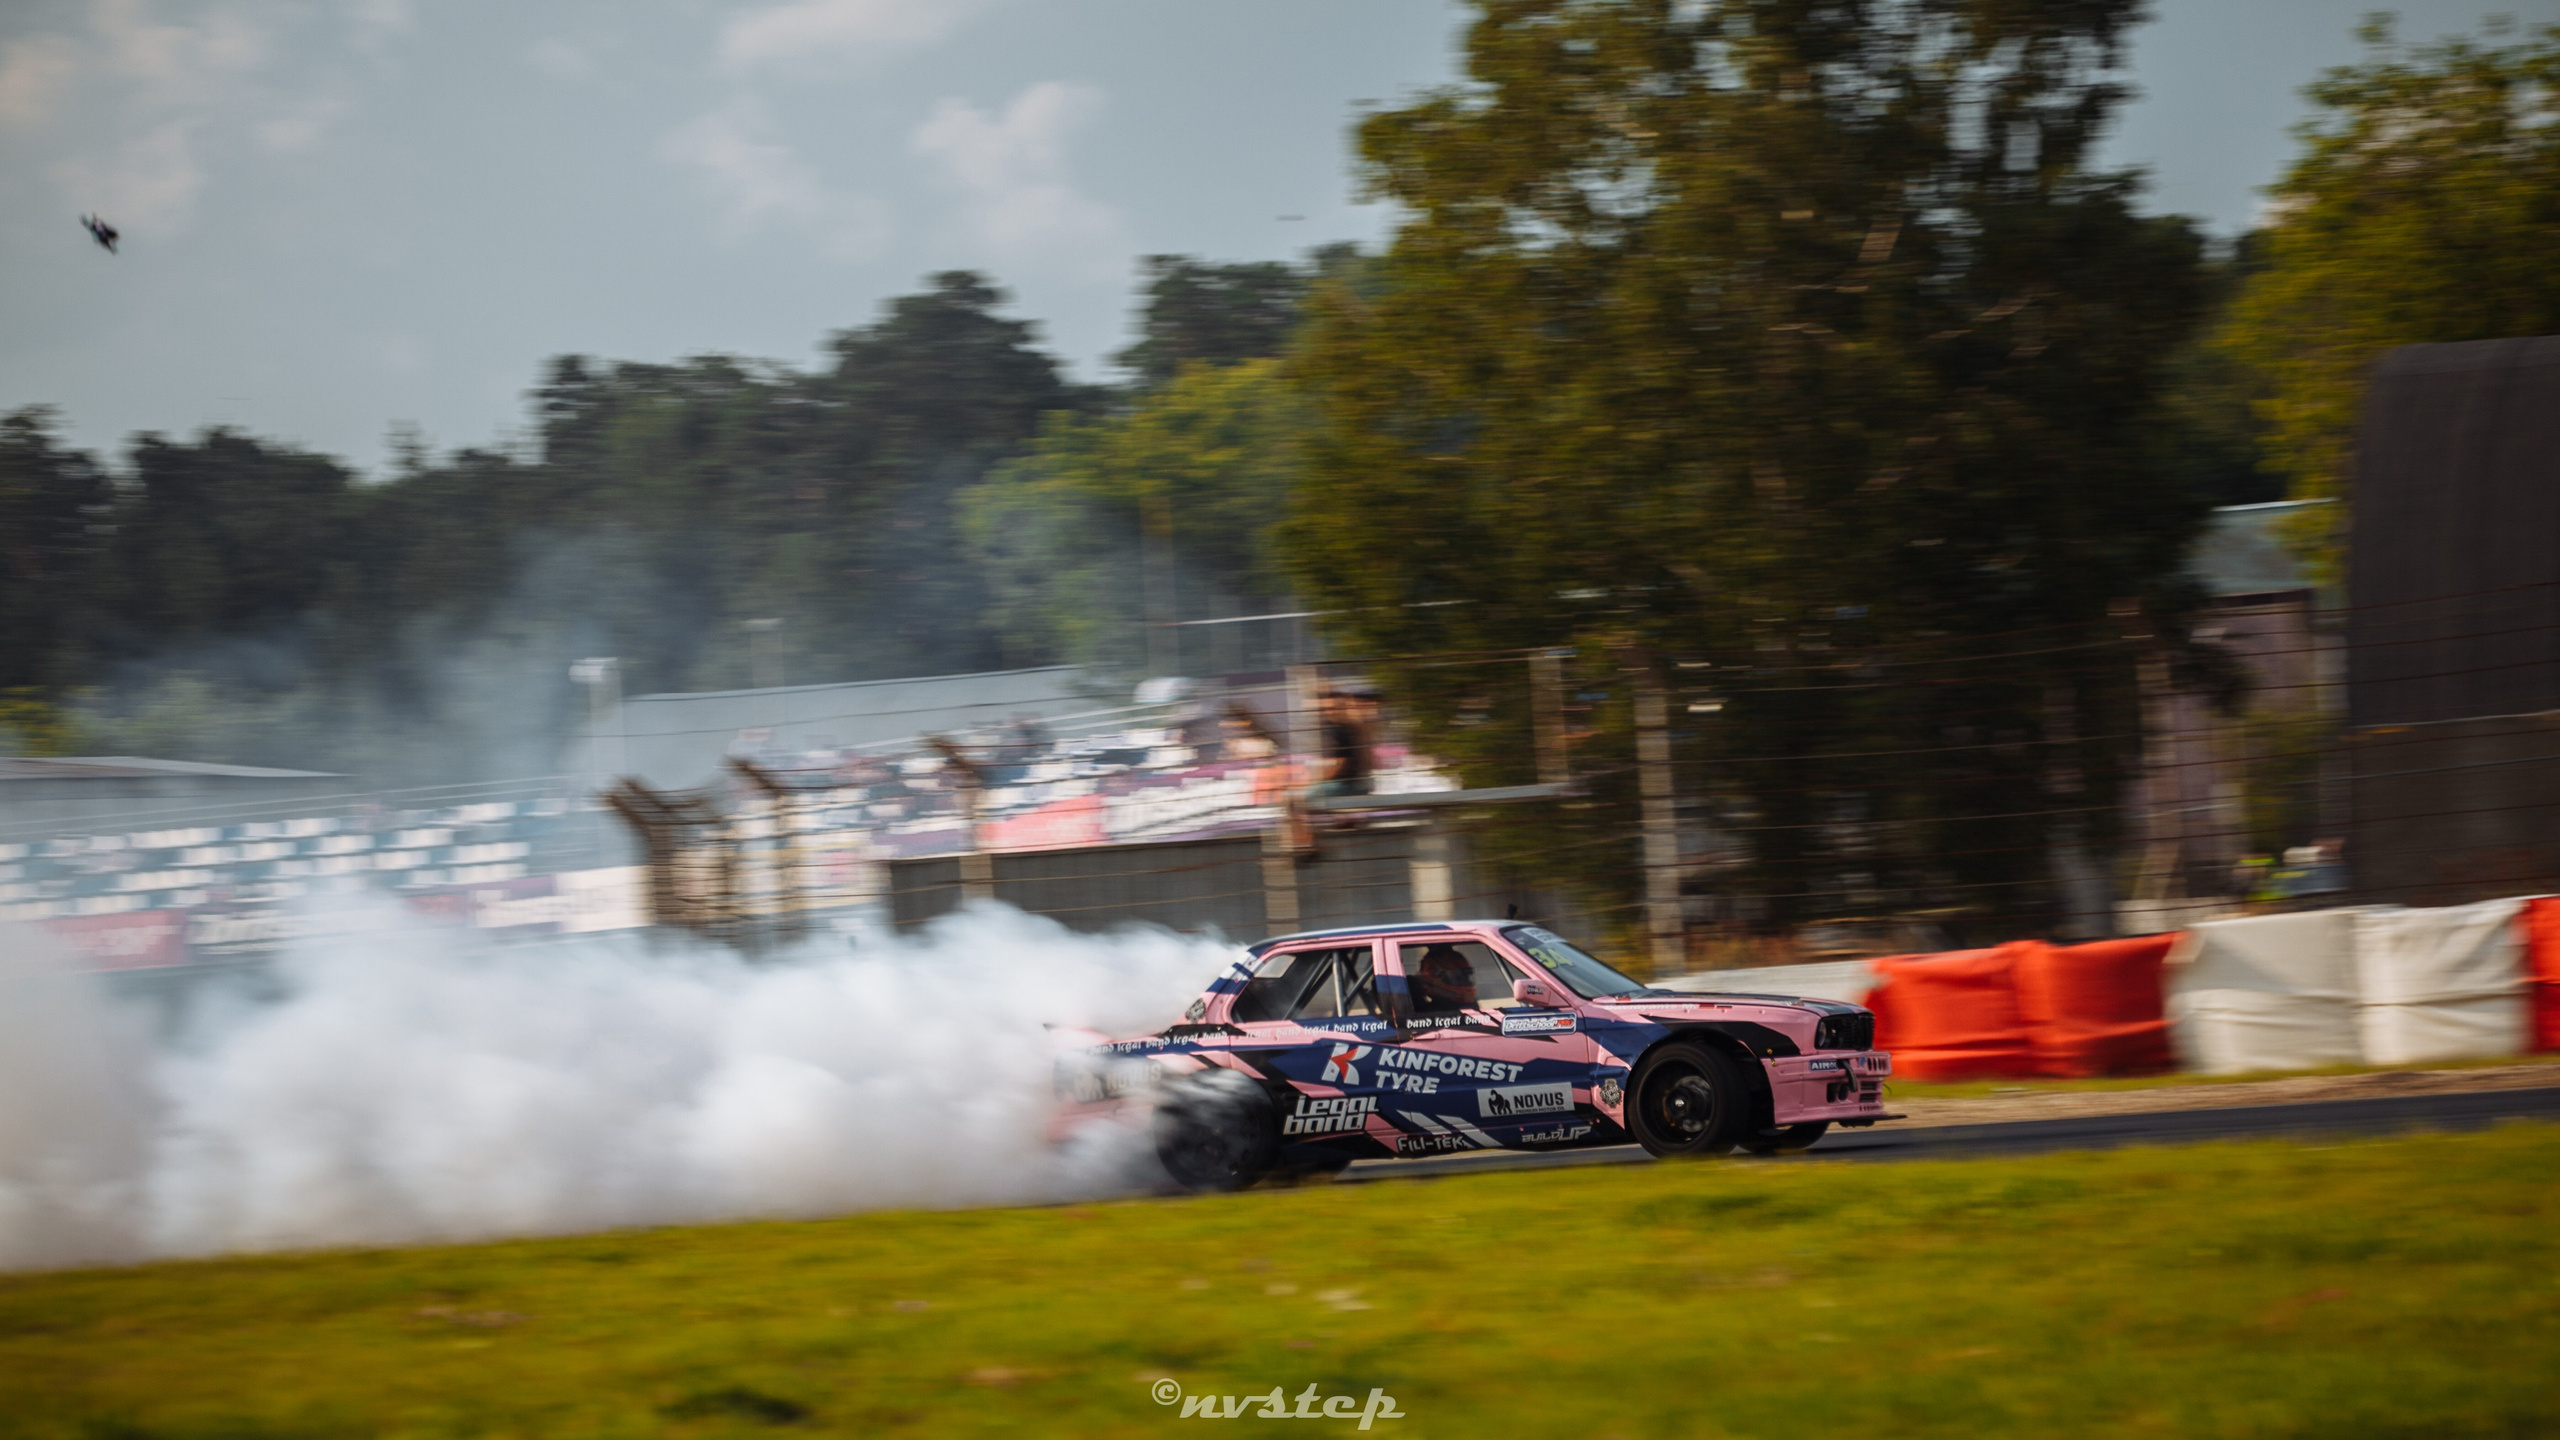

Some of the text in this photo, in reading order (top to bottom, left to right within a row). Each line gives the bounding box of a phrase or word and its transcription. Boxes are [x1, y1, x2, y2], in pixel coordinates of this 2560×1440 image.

[1173, 1032, 1199, 1045] legal
[1304, 1024, 1329, 1036] legal
[1333, 1022, 1358, 1033] band
[1362, 1019, 1388, 1032] legal
[1406, 1014, 1491, 1029] band legal band
[1378, 1048, 1524, 1083] KINFOREST
[1375, 1071, 1440, 1095] TYRE
[1513, 1092, 1564, 1109] NOVUS
